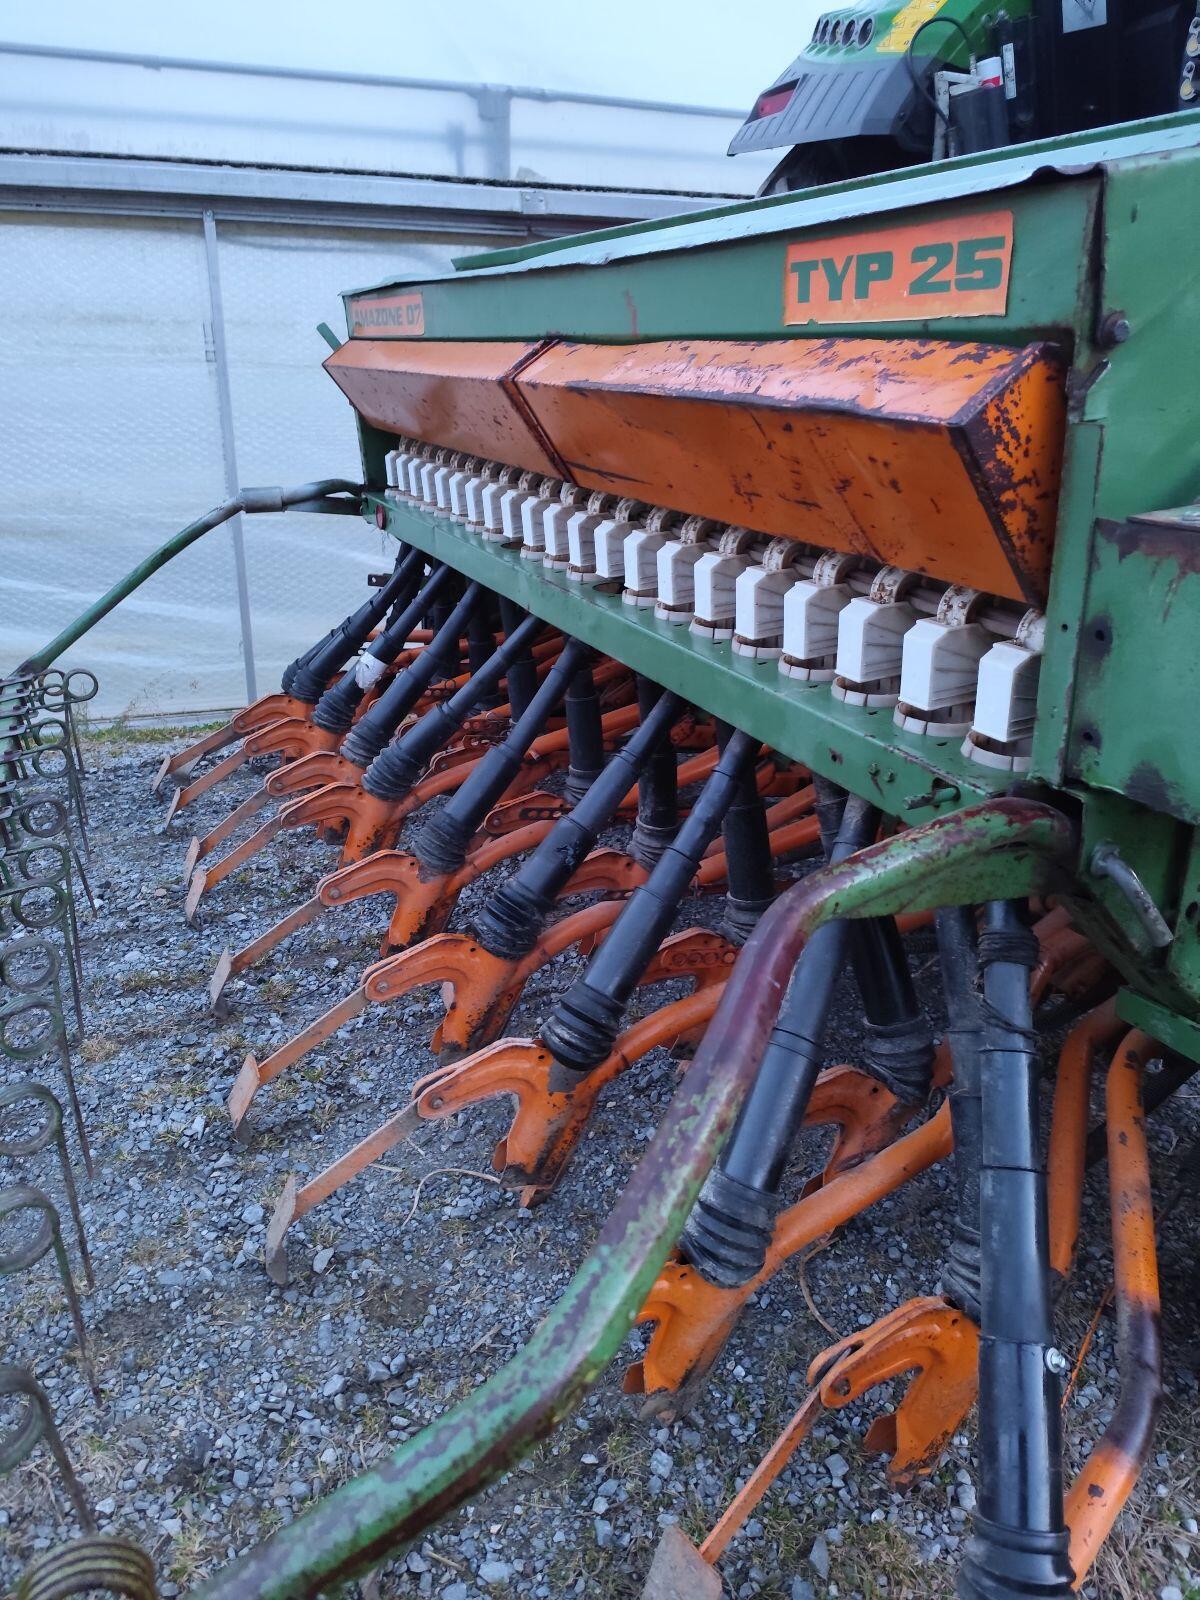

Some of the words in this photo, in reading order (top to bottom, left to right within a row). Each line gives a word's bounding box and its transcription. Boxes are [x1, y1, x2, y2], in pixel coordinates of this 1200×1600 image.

[790, 251, 894, 304] TYP
[908, 236, 1006, 296] 25
[354, 306, 403, 327] AMAZONE
